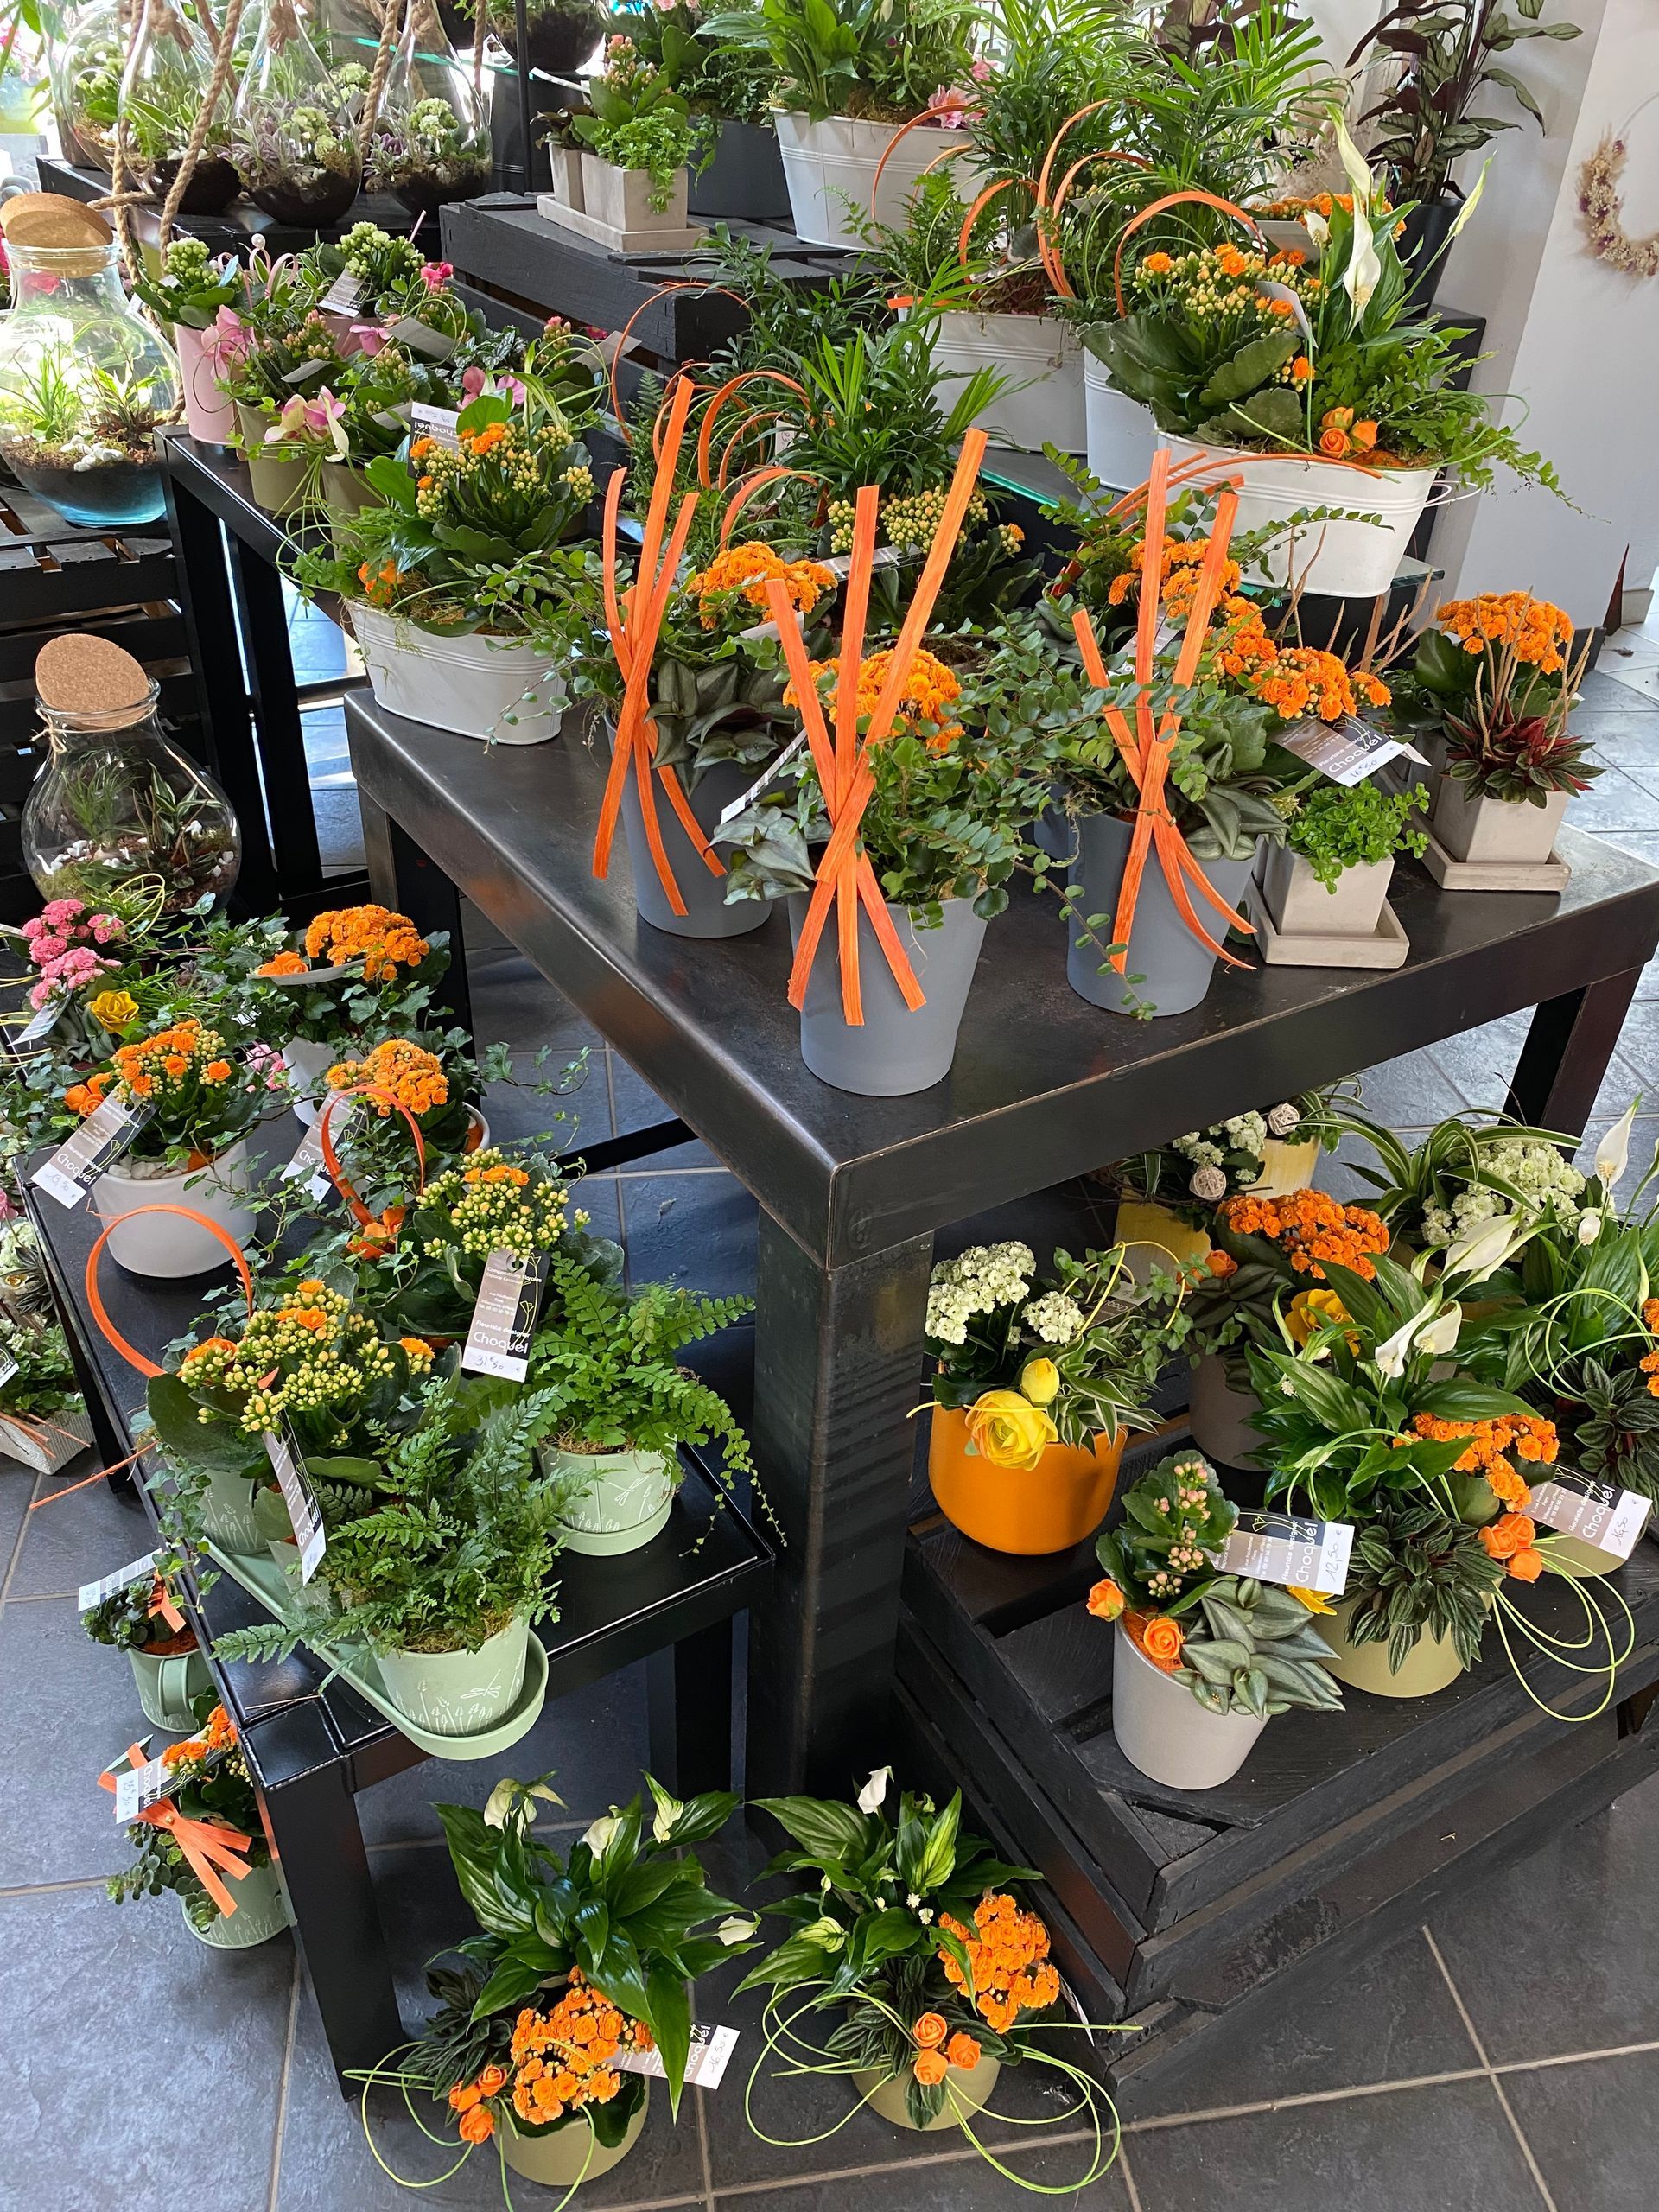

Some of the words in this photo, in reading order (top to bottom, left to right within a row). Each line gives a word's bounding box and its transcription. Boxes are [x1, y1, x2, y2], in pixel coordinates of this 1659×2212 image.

[1328, 734, 1383, 772] Choquel
[56, 1153, 97, 1185] Choquel
[474, 1331, 529, 1354] Choquel
[1568, 1506, 1584, 1531] Fleuriste
[1581, 1479, 1596, 1506] designer
[1582, 1484, 1616, 1539] Choquel
[1281, 1547, 1293, 1580] Fleuriste
[1287, 1520, 1298, 1548] designer
[1295, 1522, 1319, 1583] Choquel
[1325, 1542, 1343, 1582] 12,50
[143, 1765, 153, 1808] Choquel
